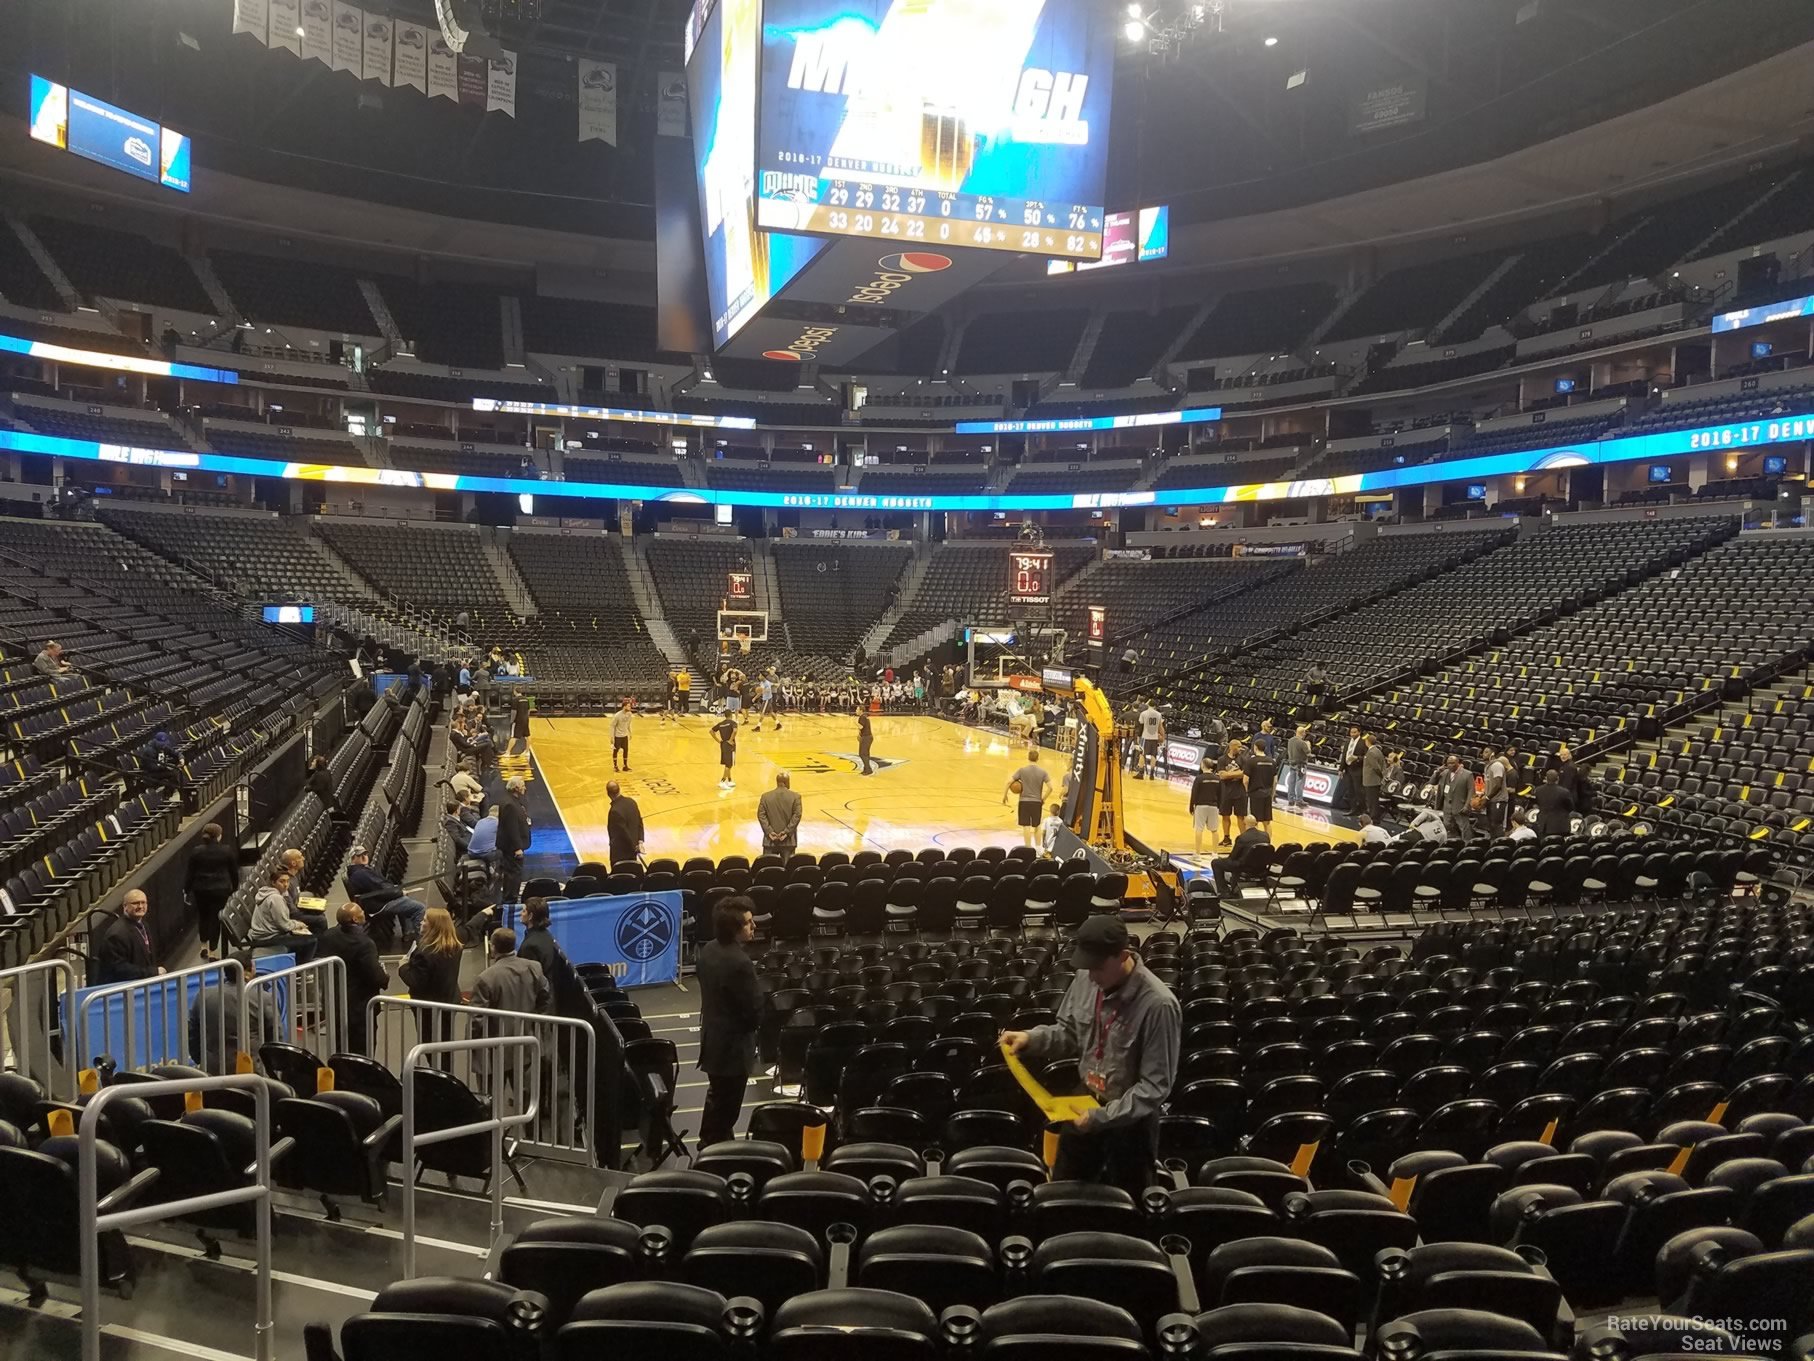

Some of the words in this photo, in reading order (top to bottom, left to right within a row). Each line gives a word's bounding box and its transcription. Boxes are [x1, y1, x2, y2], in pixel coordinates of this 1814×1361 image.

[827, 157, 866, 170] DENVER
[885, 186, 898, 194] 3RD
[938, 191, 956, 200] TOTAL
[830, 189, 848, 205] 29
[856, 192, 874, 208] 29
[882, 194, 900, 211] 32
[908, 197, 925, 214] 37
[941, 200, 950, 216] 0
[976, 204, 992, 220] 57
[998, 209, 1007, 219] %
[1024, 209, 1041, 225] 50
[1047, 214, 1055, 224] %
[1069, 214, 1085, 229] 76
[1090, 218, 1099, 228] %
[829, 212, 847, 228] 33
[855, 215, 873, 231] 20
[881, 217, 899, 234] 24
[907, 220, 924, 237] 22
[940, 223, 949, 239] 0
[1023, 232, 1040, 248] 28
[1067, 235, 1084, 251] 82
[848, 272, 912, 304] pepsi
[788, 326, 839, 352] pepsi
[1690, 426, 1760, 448] 2016-17
[784, 496, 828, 505] 2016-17
[834, 497, 876, 506] DENVER
[882, 498, 932, 508] NUGGETS
[847, 530, 868, 539] KIDS
[1074, 722, 1088, 783] xfinity
